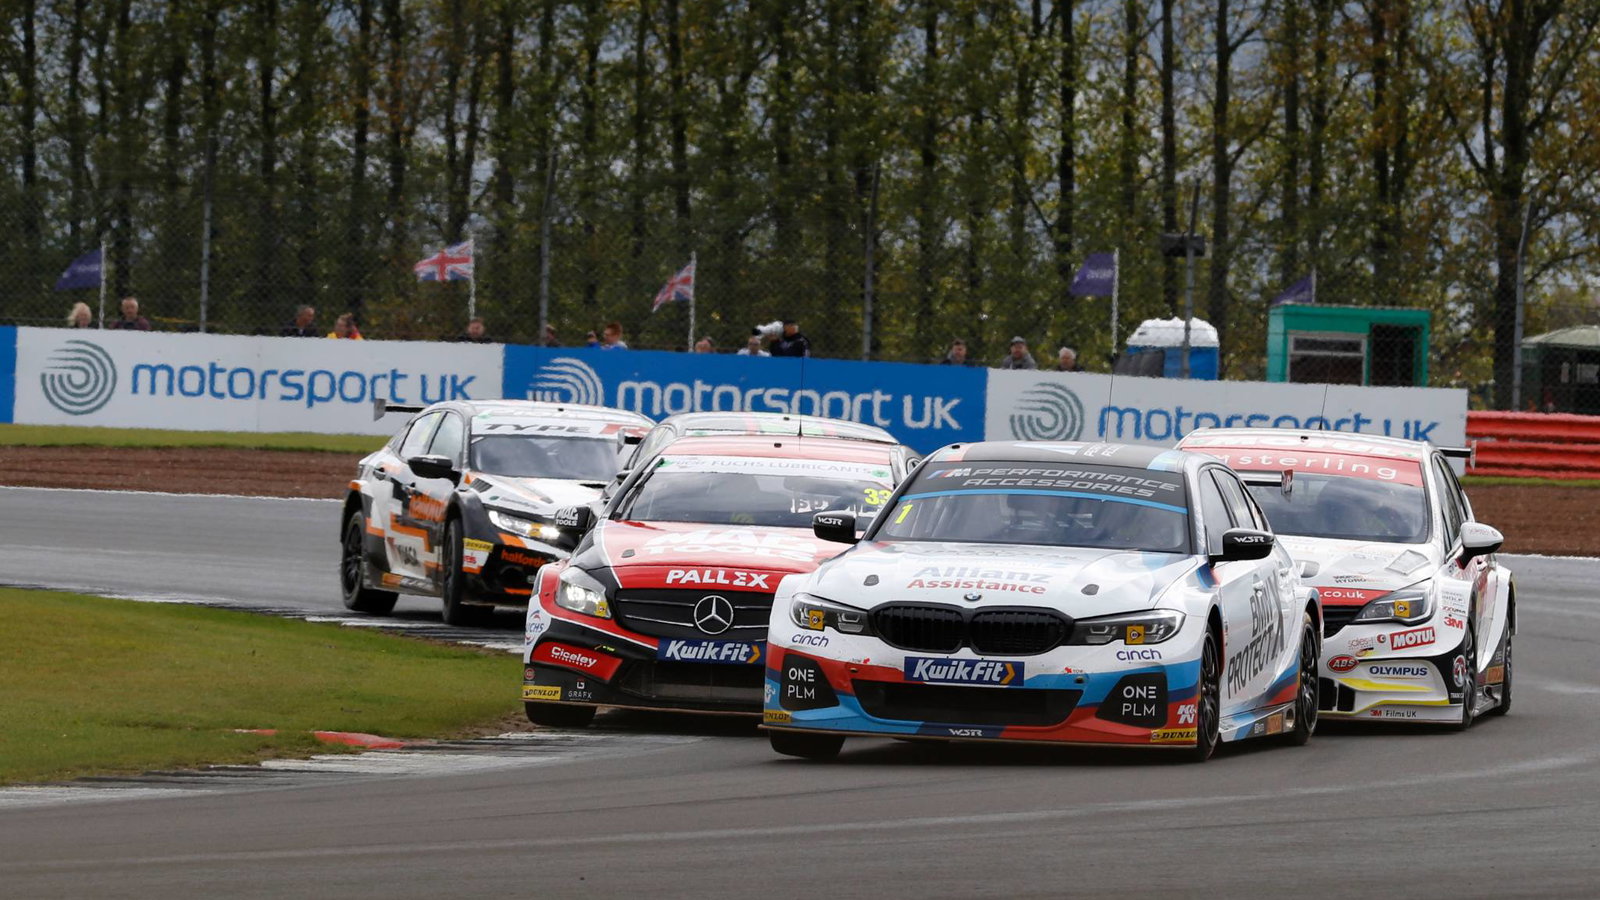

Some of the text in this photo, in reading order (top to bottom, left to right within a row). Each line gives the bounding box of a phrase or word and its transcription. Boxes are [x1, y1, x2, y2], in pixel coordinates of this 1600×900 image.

[131, 362, 475, 408] motorsport UK
[903, 396, 963, 431] UK
[483, 423, 591, 433] TYPE
[1239, 455, 1398, 481] sterling
[972, 467, 1180, 492] PERFORMANCE
[963, 477, 1156, 497] ACCESSORIES
[864, 487, 892, 505] 33
[818, 516, 842, 526] WSR
[895, 504, 913, 525] 1
[912, 566, 1050, 584] Allianz
[906, 578, 1047, 595] Assistance
[1443, 616, 1463, 630] 3M
[792, 634, 829, 648] cinch
[1393, 629, 1435, 648] MOTUL
[1116, 648, 1162, 662] cinch
[788, 667, 815, 682] ONE
[1369, 666, 1428, 676] OLYMPUS
[529, 689, 559, 697] DUNLOP
[787, 684, 815, 700] PLM
[1122, 685, 1157, 699] ONE
[1122, 703, 1156, 716] PLM
[1386, 709, 1405, 718] Films
[1407, 709, 1417, 718] UK
[949, 728, 982, 737] WSR
[1161, 730, 1197, 740] DUNLO
